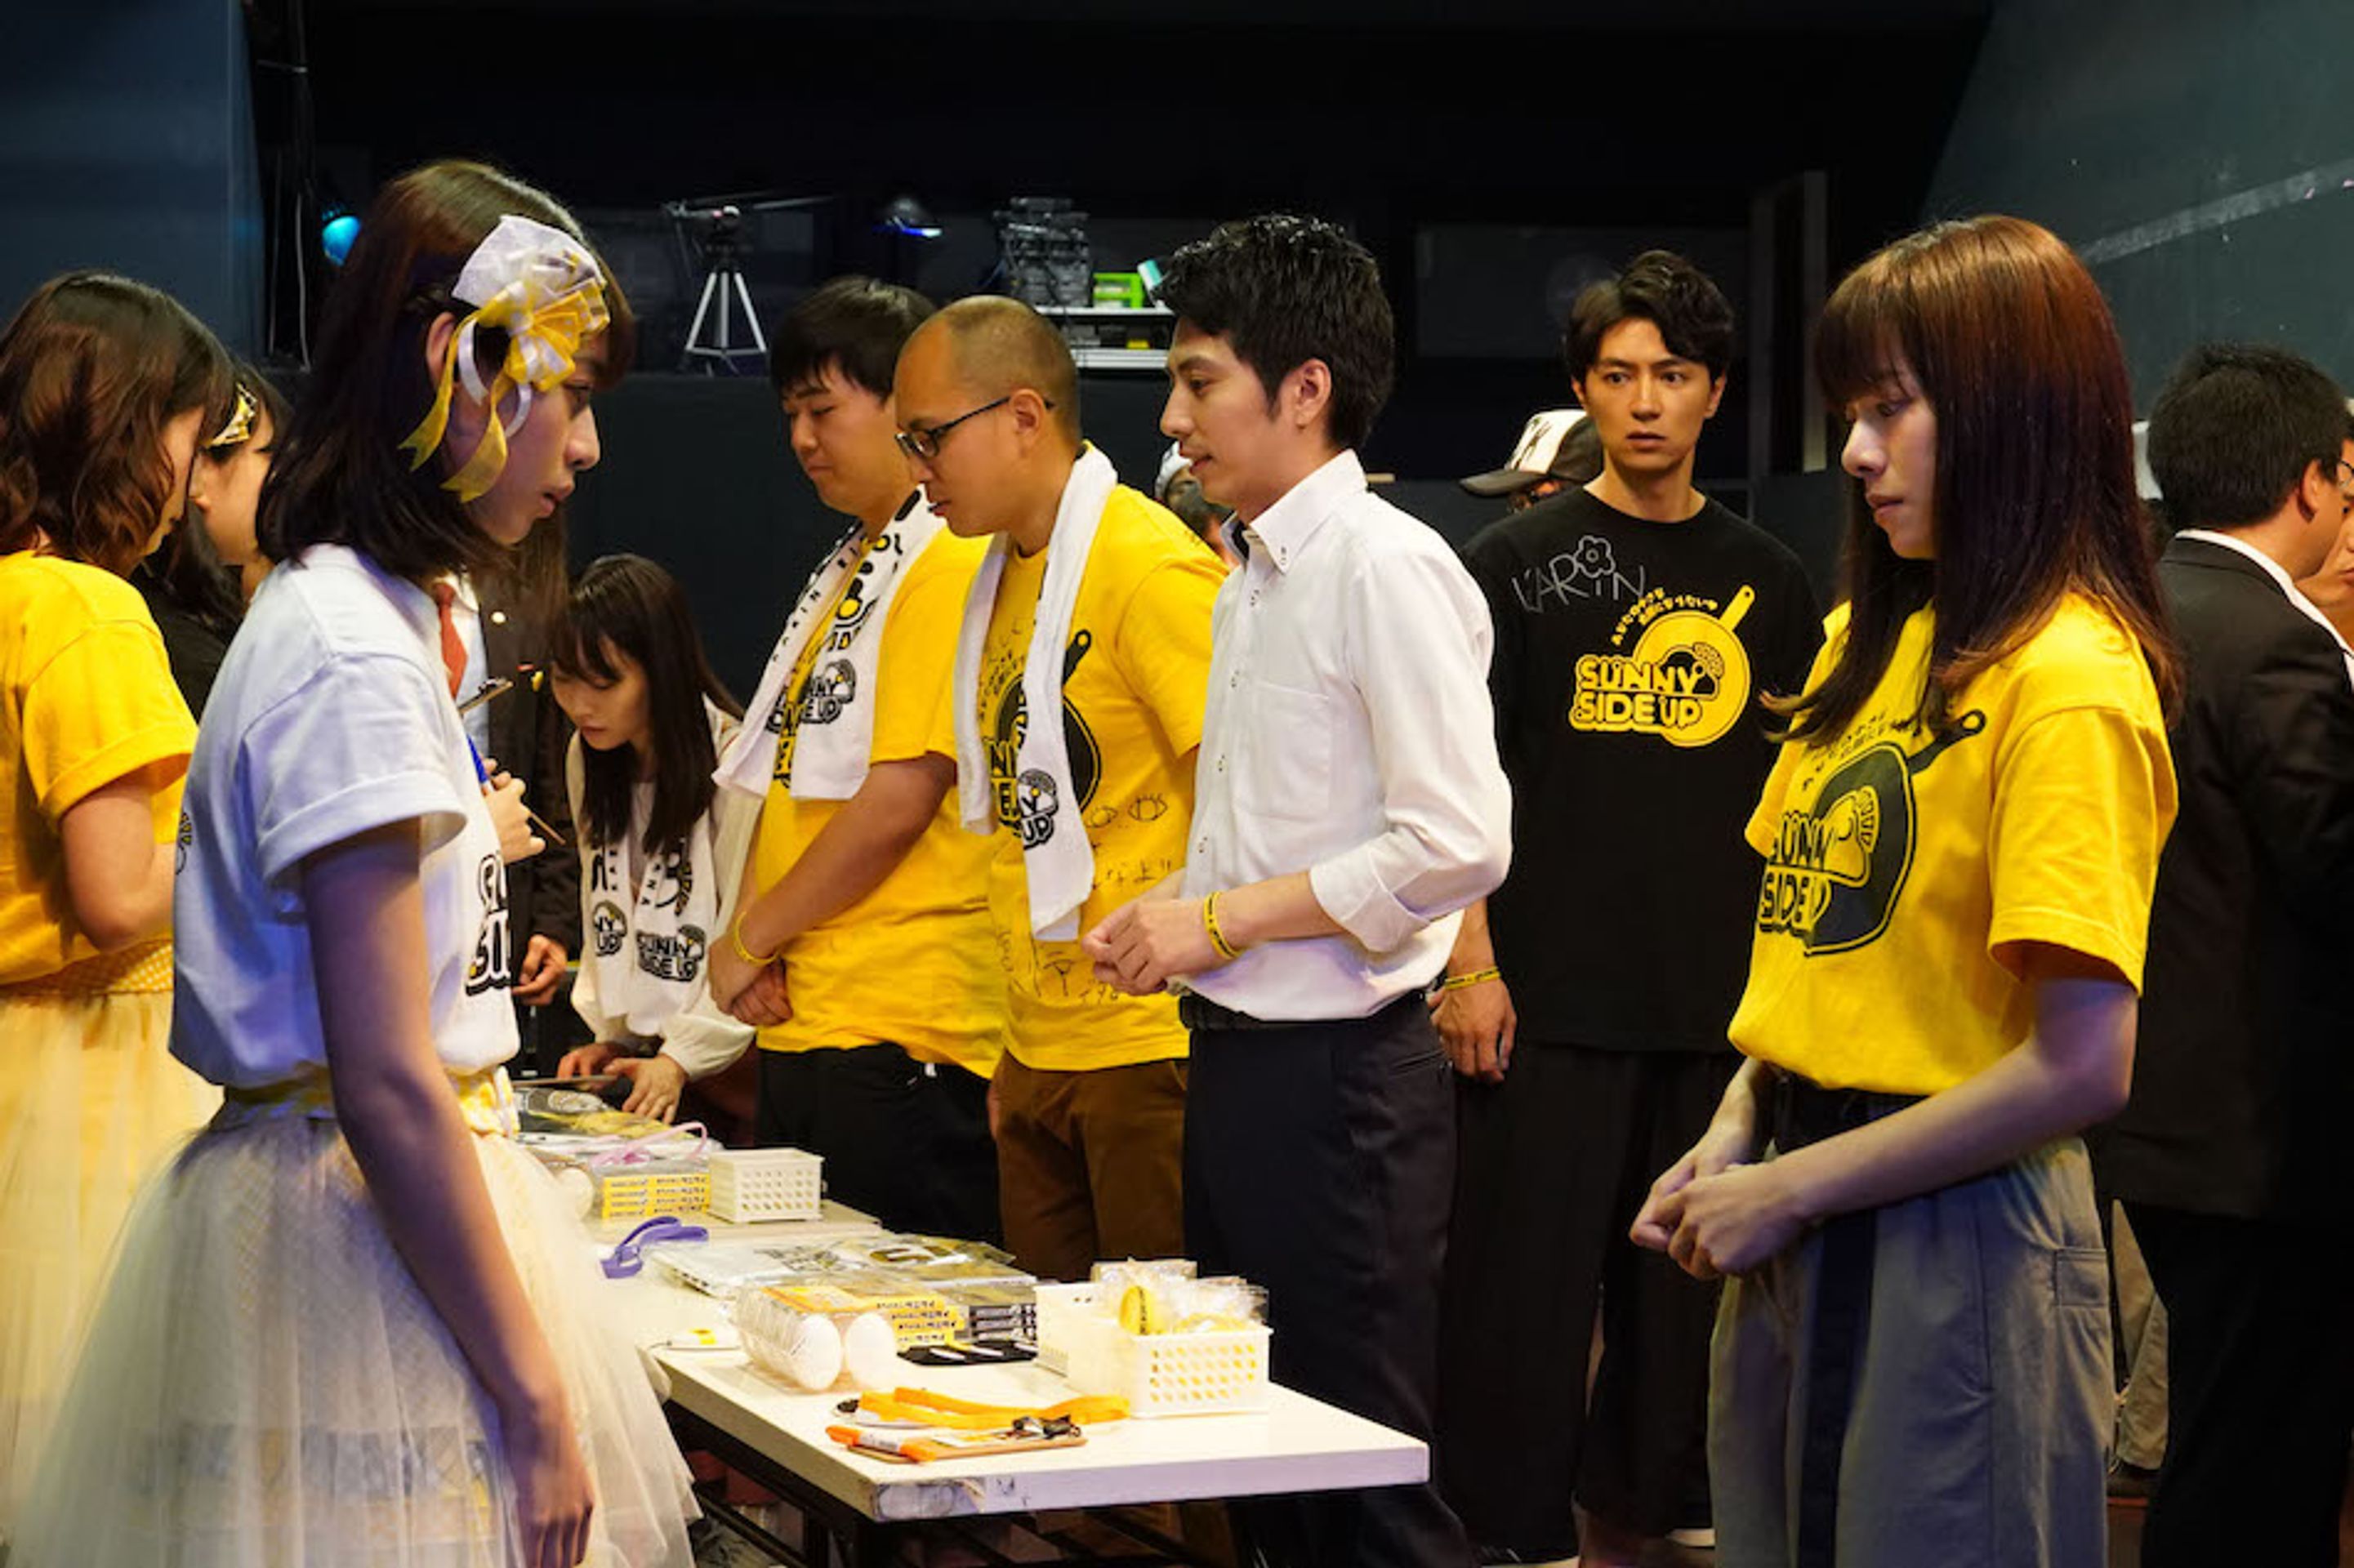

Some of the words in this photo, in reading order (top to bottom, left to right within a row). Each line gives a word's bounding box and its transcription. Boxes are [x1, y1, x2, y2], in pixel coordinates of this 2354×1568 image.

[1580, 658, 1703, 694] SUNNY
[1577, 693, 1656, 724] SIDE
[1659, 697, 1701, 728] UP
